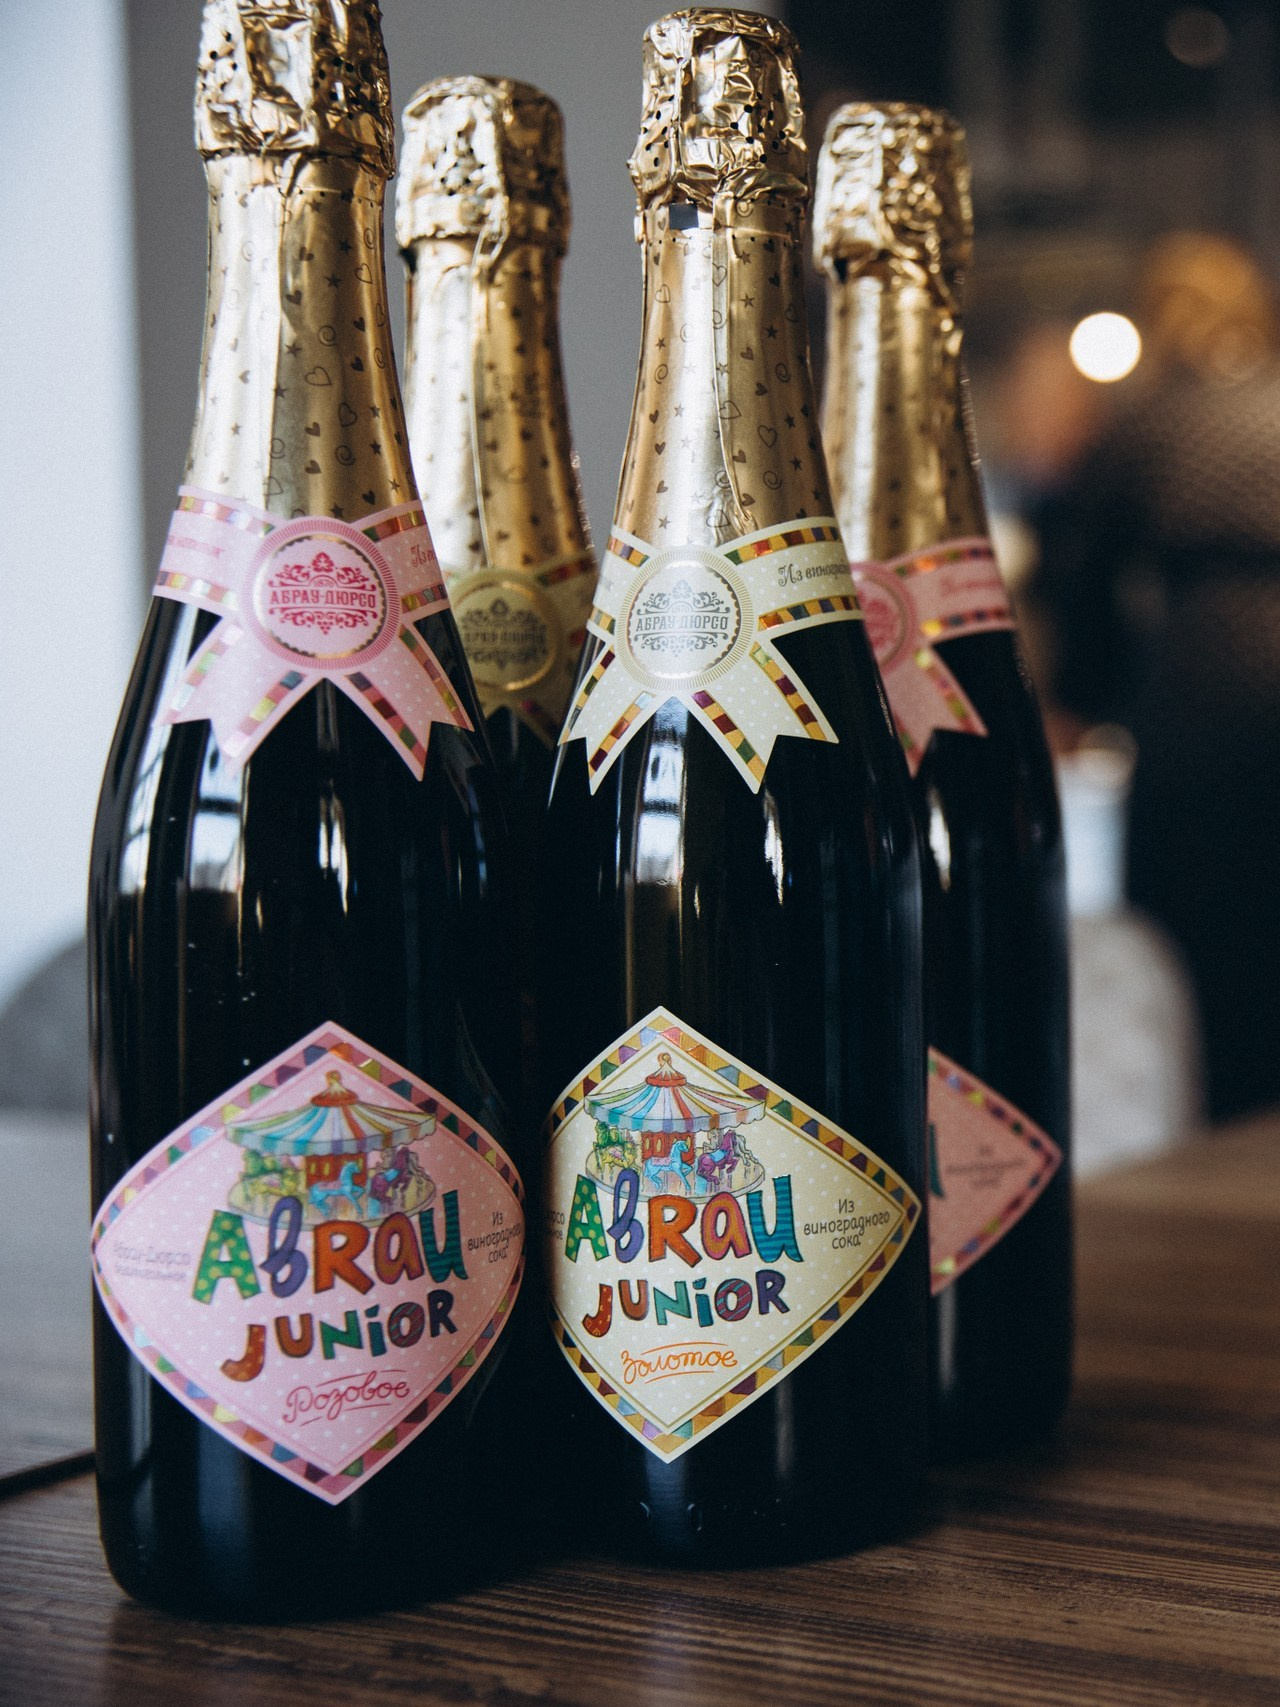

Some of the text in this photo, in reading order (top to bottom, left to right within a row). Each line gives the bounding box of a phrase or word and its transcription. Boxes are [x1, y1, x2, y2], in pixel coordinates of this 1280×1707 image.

[778, 563, 803, 588] Из
[270, 589, 376, 608] АБРАУ-ДЮРСО
[635, 614, 729, 632] АБРАУ-ДЮРСО
[838, 1199, 855, 1214] Из
[492, 1211, 504, 1226] Из
[803, 1211, 890, 1236] виноградного
[831, 1234, 861, 1250] сока
[620, 1349, 738, 1384] Золотое
[282, 1371, 411, 1420] Розовое
